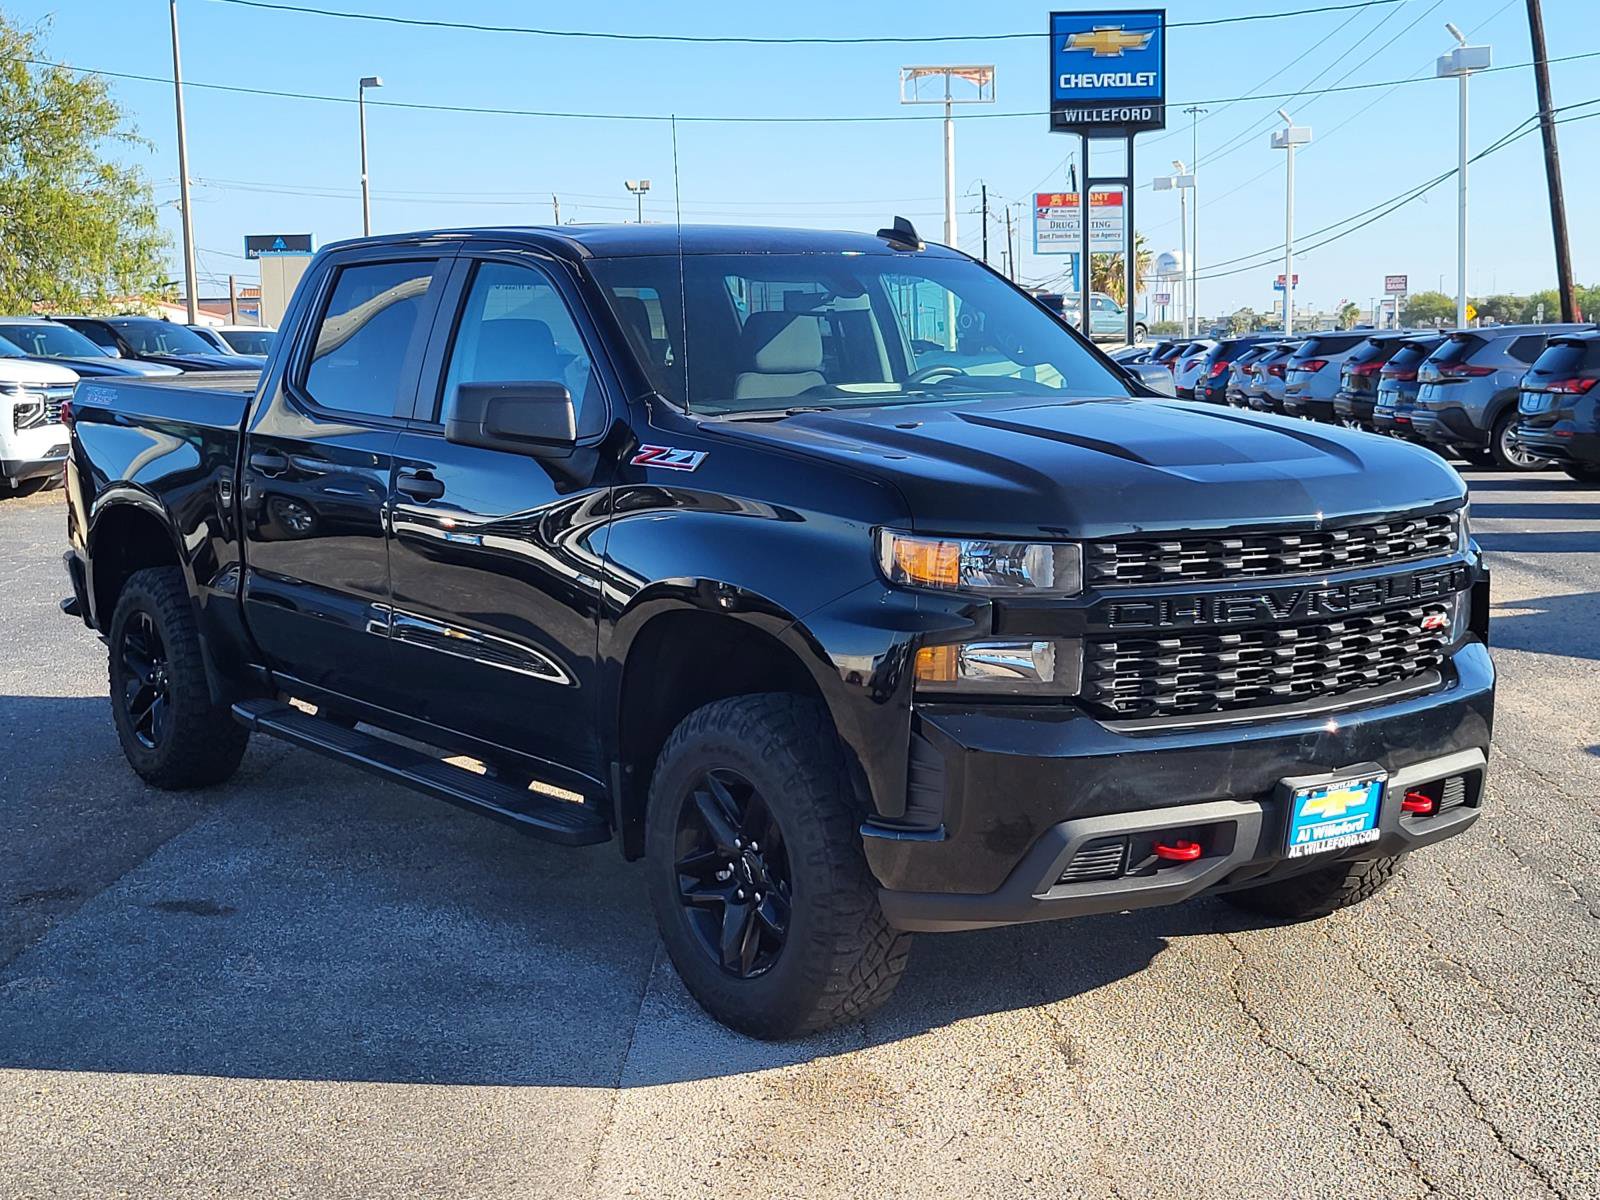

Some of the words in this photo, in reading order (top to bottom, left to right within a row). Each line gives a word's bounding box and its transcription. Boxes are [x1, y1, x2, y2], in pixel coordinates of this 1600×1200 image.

[1060, 72, 1157, 88] CHEVROLET
[1065, 108, 1152, 122] WILLEFORD
[1050, 221, 1074, 229] DRUG
[1101, 231, 1121, 240] Agency
[630, 444, 710, 472] Z71
[1108, 566, 1465, 628] CHEVROLET
[1296, 829, 1311, 843] Al
[1313, 818, 1365, 840] Willeford
